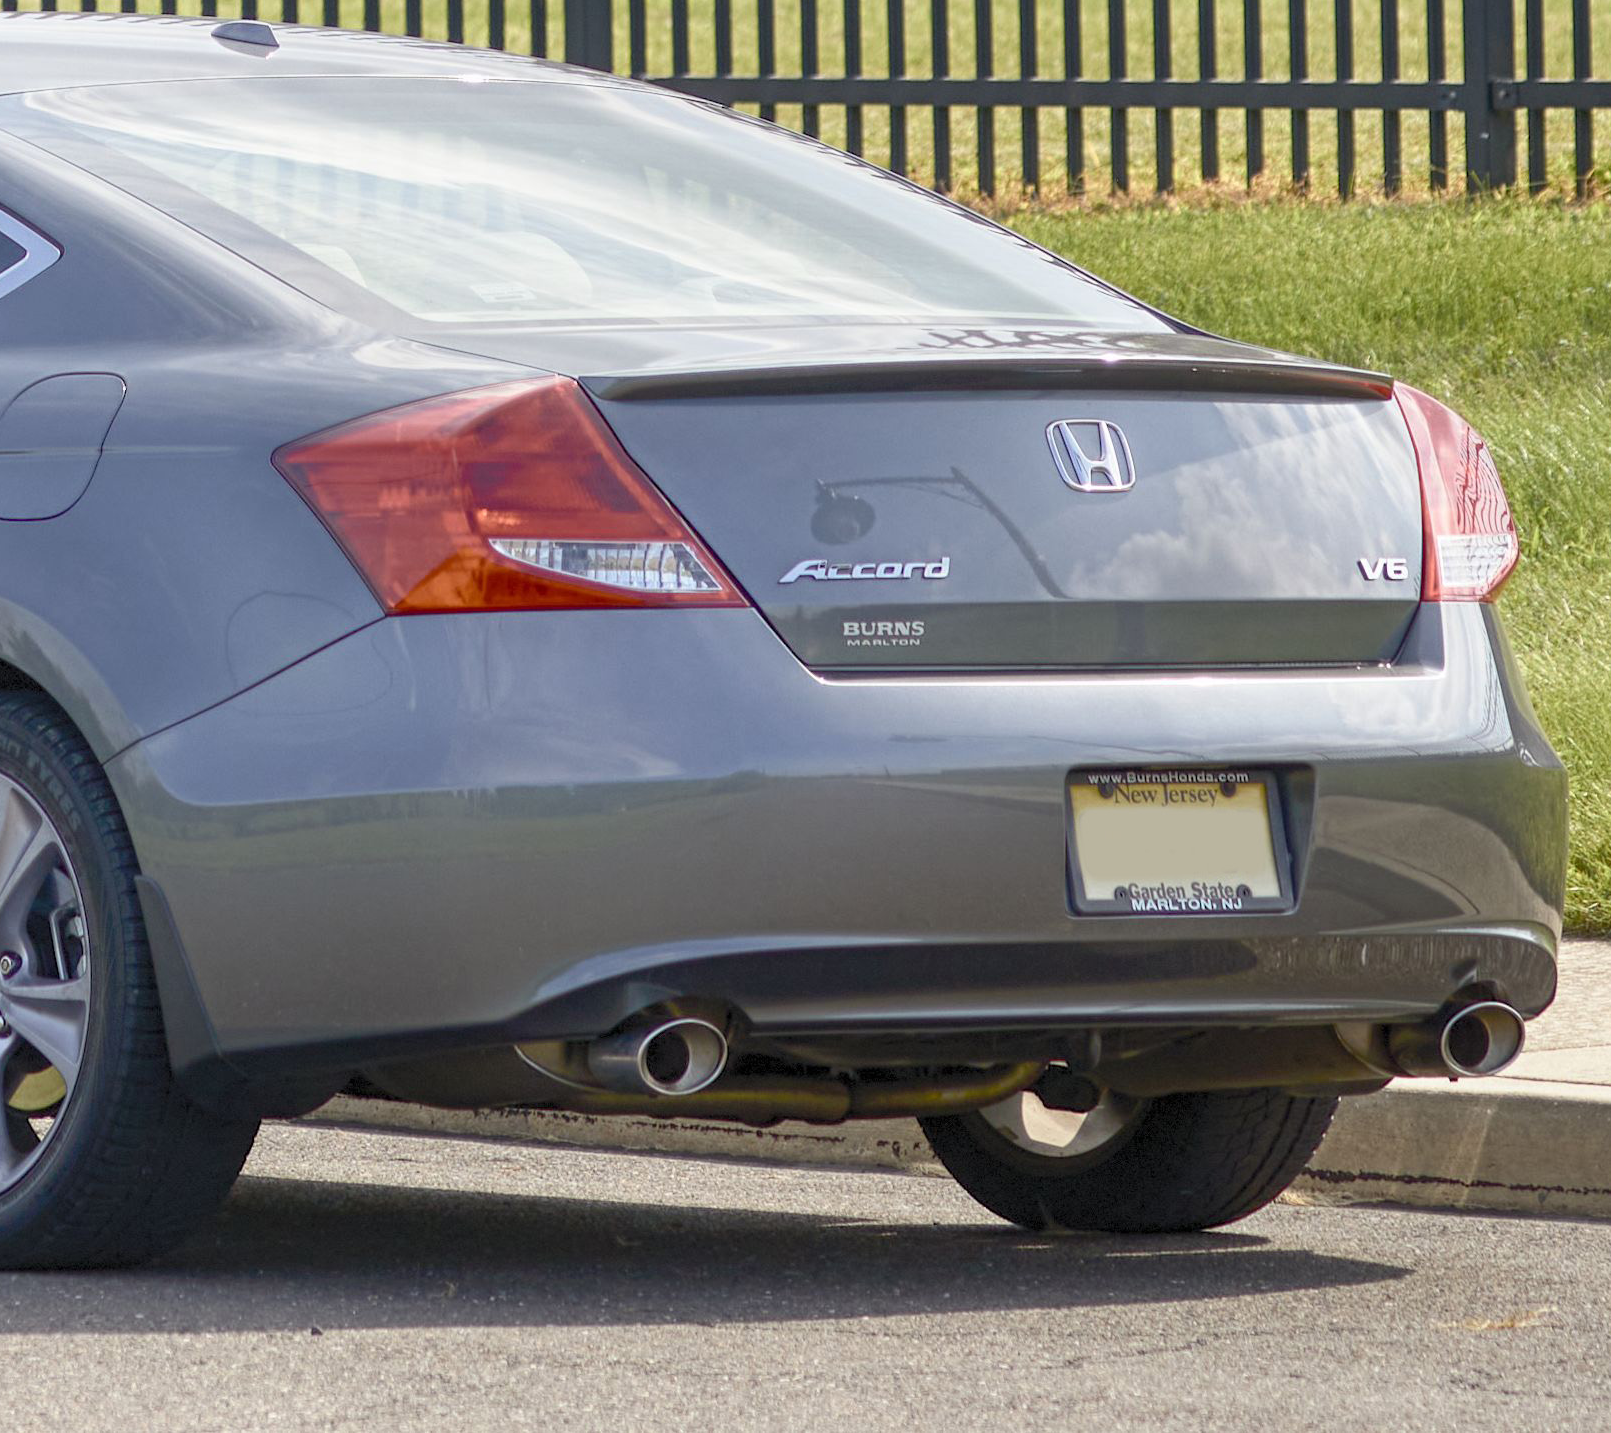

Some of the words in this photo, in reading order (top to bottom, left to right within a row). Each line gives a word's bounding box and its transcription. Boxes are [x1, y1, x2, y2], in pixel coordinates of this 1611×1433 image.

[778, 557, 951, 585] Accord
[1357, 558, 1409, 581] V6
[842, 621, 926, 637] BURNS
[846, 638, 921, 647] MARLTON
[1088, 771, 1249, 784] www.BurnsHonda.com
[1113, 784, 1158, 804] New
[1161, 784, 1219, 807] Jersey
[1128, 881, 1186, 900] Garden
[1191, 881, 1235, 899] State
[1221, 897, 1243, 910] NJ
